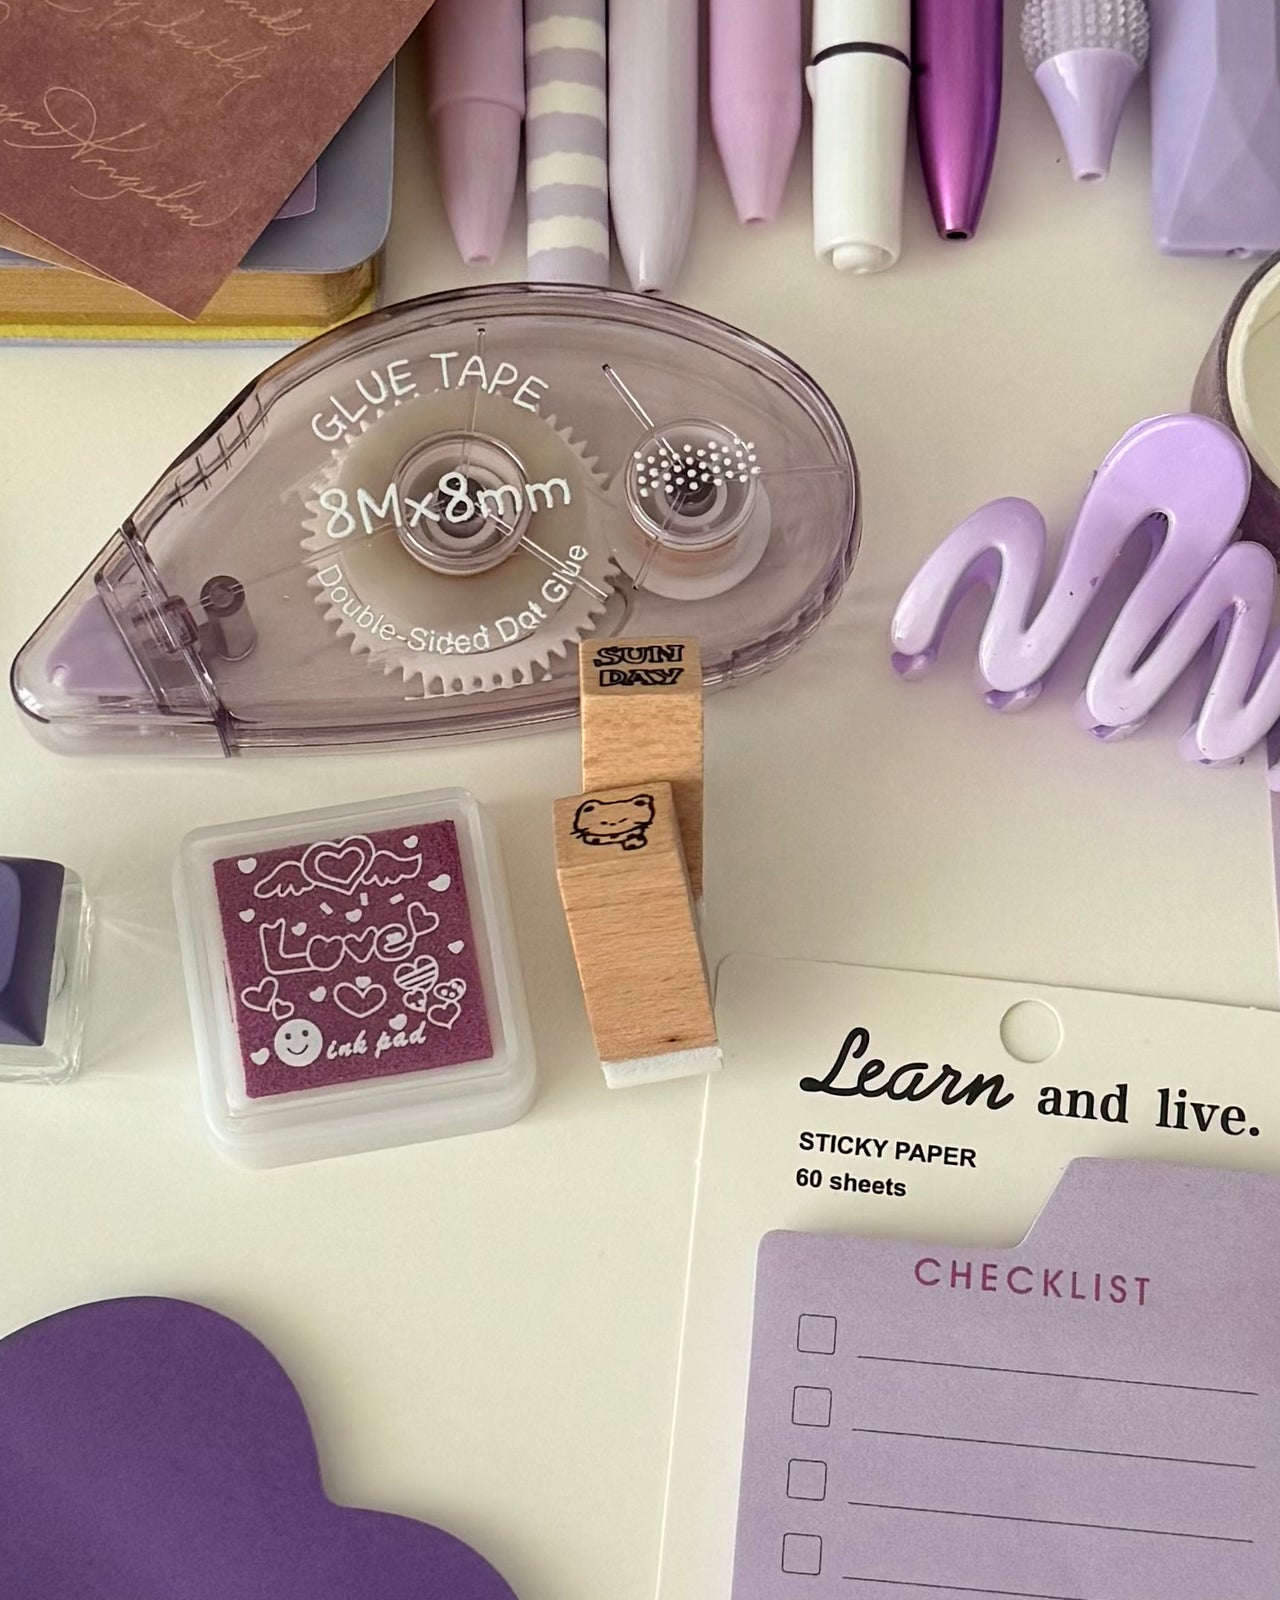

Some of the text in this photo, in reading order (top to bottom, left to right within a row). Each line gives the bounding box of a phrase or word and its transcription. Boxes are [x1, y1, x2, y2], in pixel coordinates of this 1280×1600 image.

[310, 351, 550, 443] GLUE TAPE
[319, 470, 572, 540] 8Mx8mm
[316, 543, 590, 656] Double-Sided Dot Glue
[592, 643, 686, 666] SUN
[599, 667, 685, 687] DAY
[326, 1020, 427, 1061] ink pad
[798, 1025, 1262, 1138] Learn and live.
[797, 1129, 978, 1169] STICKY PAPER
[794, 1167, 908, 1198] 60 sheets
[912, 1256, 1152, 1306] CHECKLIST
